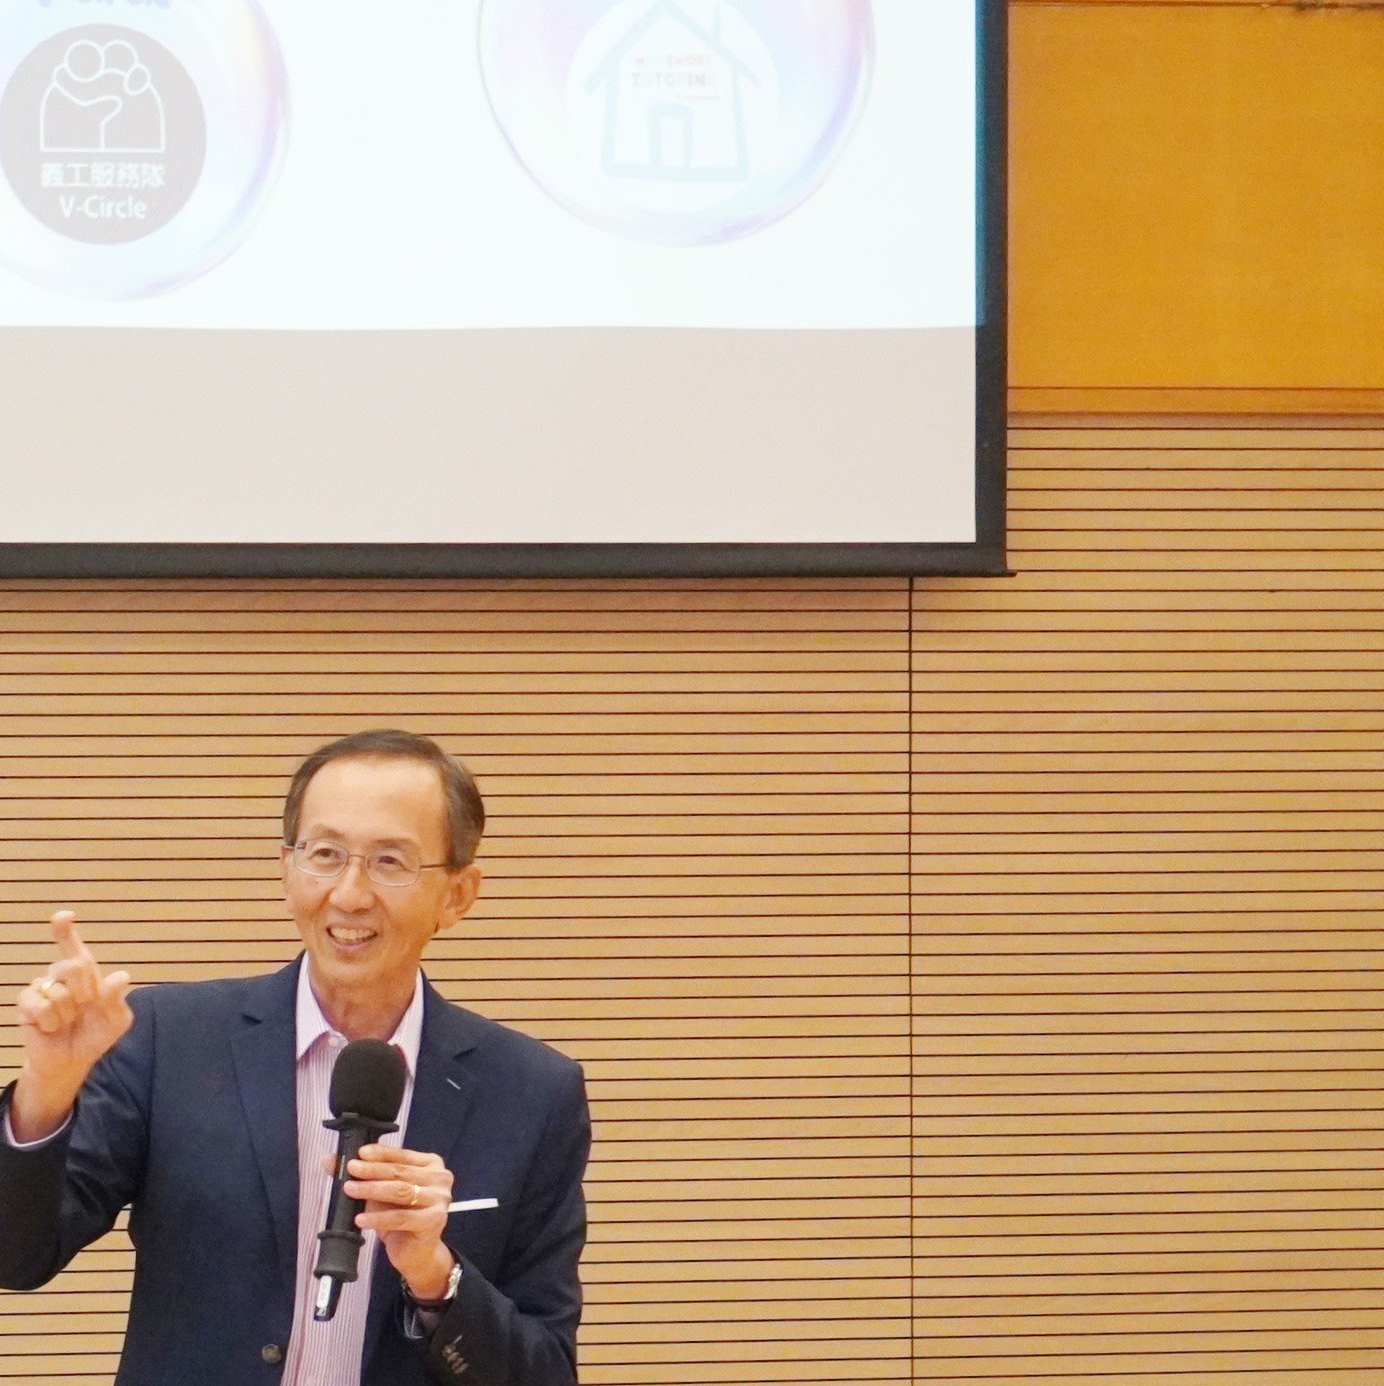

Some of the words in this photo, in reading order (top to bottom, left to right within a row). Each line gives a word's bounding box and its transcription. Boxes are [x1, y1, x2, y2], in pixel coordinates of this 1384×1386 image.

[40, 162, 166, 189] 義工服務隊
[58, 194, 148, 219] V-Circle
